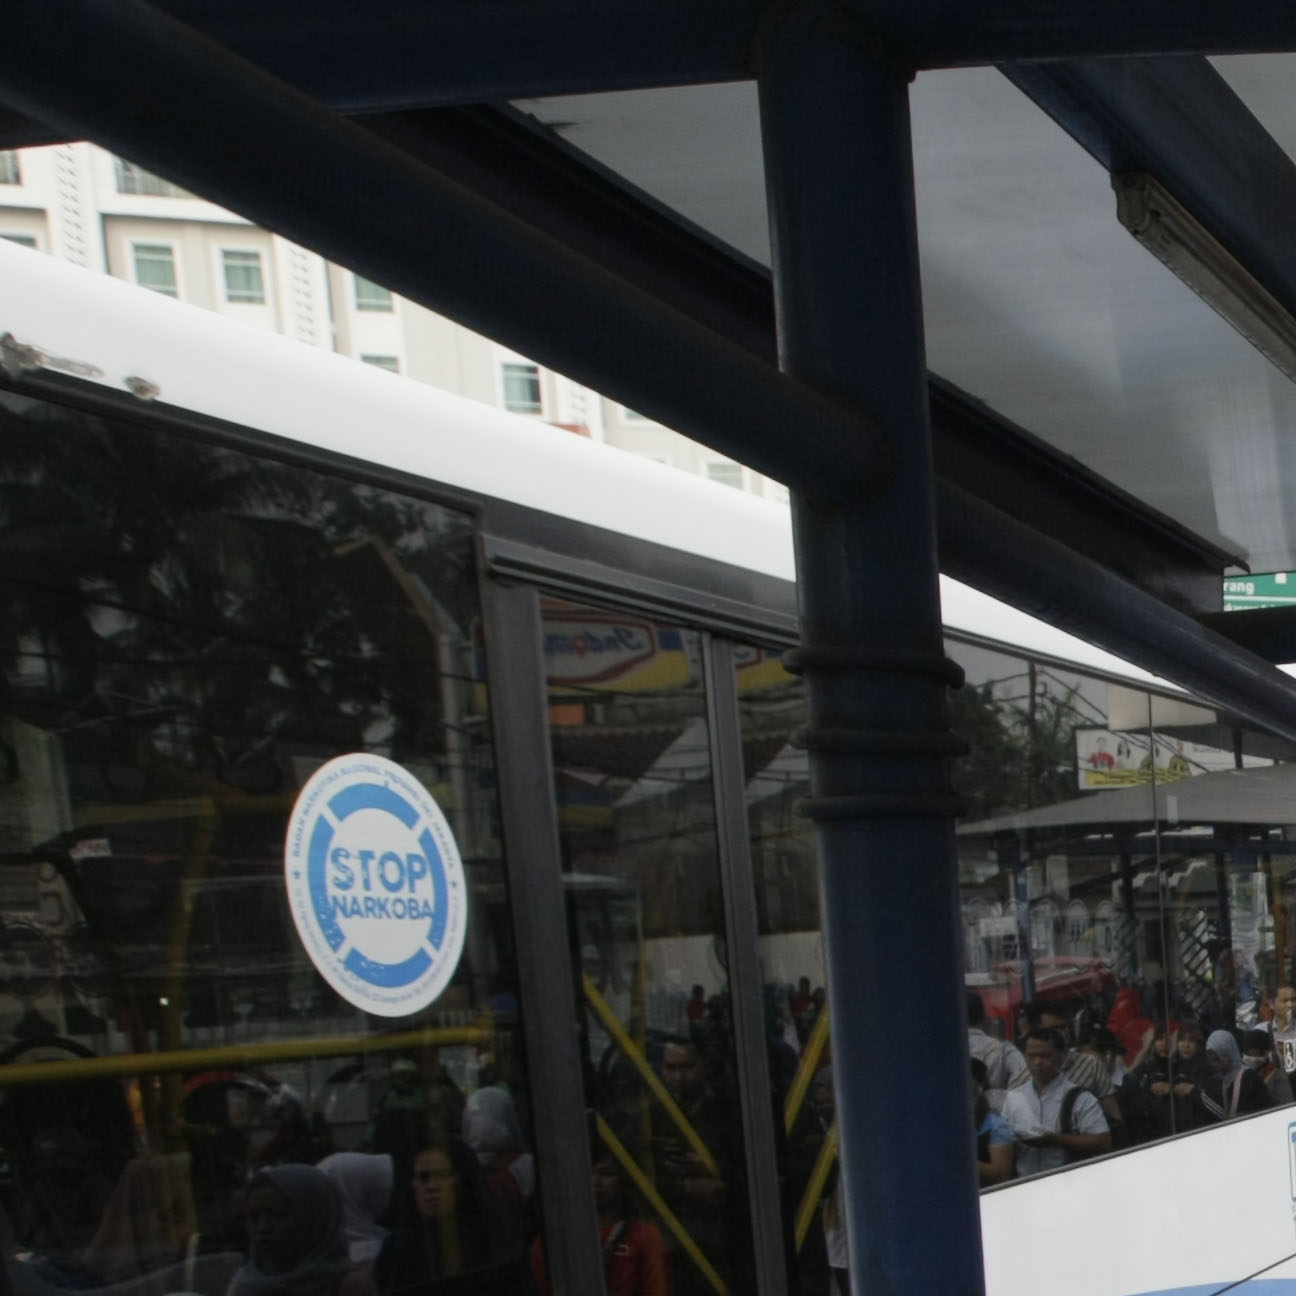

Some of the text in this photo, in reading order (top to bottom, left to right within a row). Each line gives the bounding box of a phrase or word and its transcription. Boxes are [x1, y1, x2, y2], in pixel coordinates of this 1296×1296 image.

[1224, 582, 1255, 596] rang
[331, 847, 428, 893] STOP
[332, 895, 434, 920] NARKOBA
